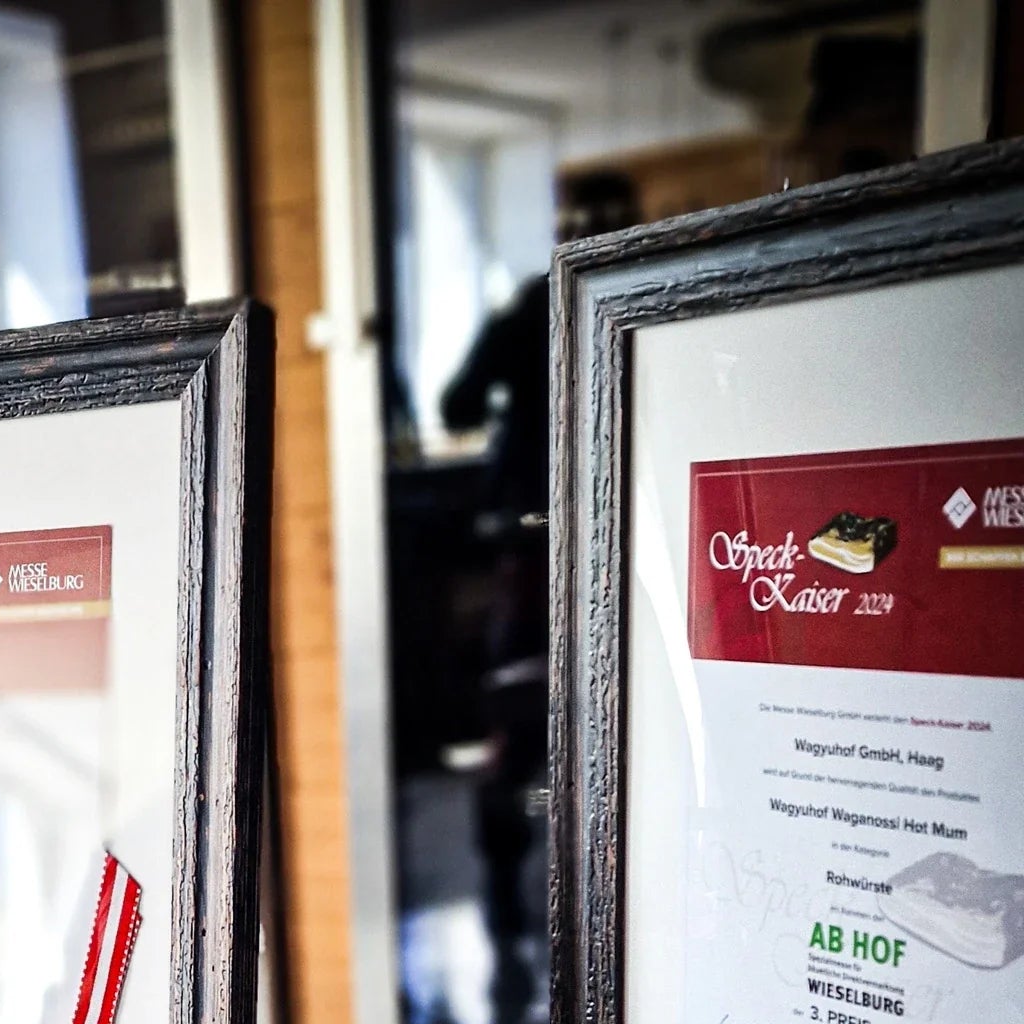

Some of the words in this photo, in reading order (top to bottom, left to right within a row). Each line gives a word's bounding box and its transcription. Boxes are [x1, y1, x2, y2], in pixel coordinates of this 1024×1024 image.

[8, 562, 48, 578] MESSE
[709, 530, 805, 583] Speck-
[8, 574, 84, 593] WIESELBURG
[750, 573, 850, 615] Kaiser
[852, 592, 895, 615] 2024
[794, 738, 856, 758] Wagyuhof
[858, 744, 904, 764] GmbH,
[907, 750, 945, 771] Haag
[769, 797, 829, 818] Wagyuhof
[831, 807, 900, 829] Waganossi
[904, 818, 928, 834] Hot
[932, 822, 968, 840] Mum
[826, 870, 893, 896] Rohwürste
[809, 922, 844, 953] AB
[852, 929, 907, 968] HOF
[808, 977, 905, 1017] WIESELBURG
[810, 1005, 824, 1022] 3.
